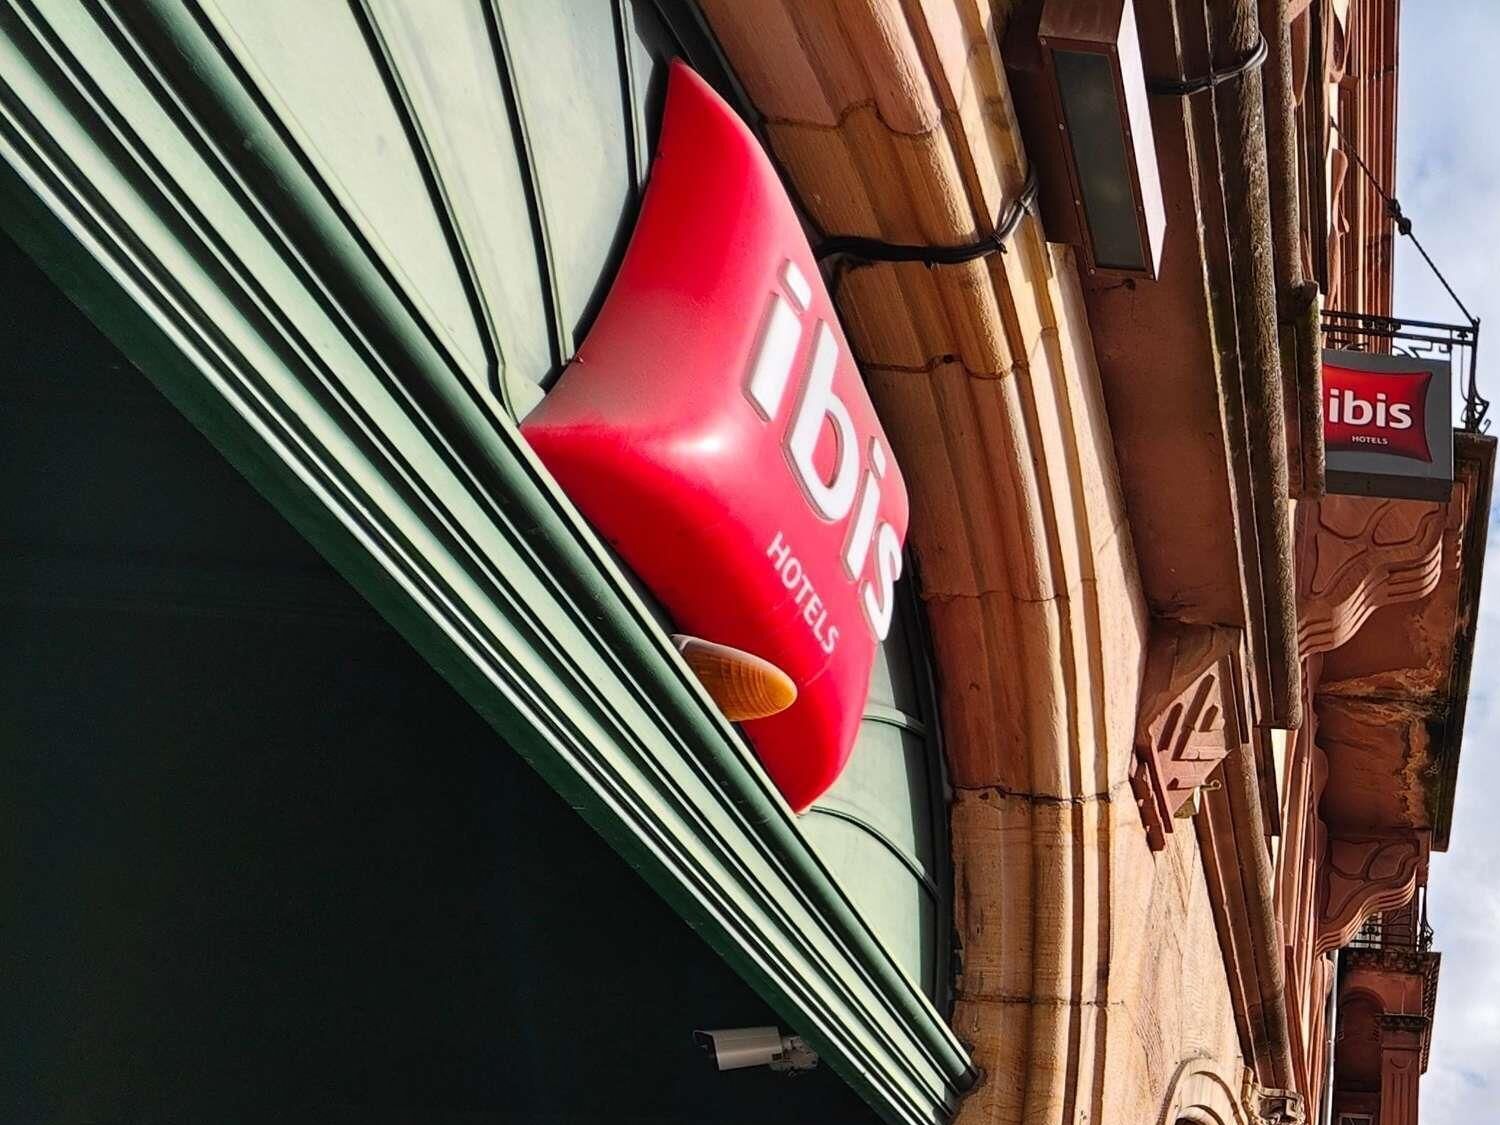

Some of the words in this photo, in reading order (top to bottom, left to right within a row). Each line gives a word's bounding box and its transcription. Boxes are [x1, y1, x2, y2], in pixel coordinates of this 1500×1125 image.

[1329, 388, 1412, 429] ibis
[1351, 435, 1388, 445] HOTELS
[743, 259, 902, 642] ibis
[766, 532, 840, 655] HOTELS
